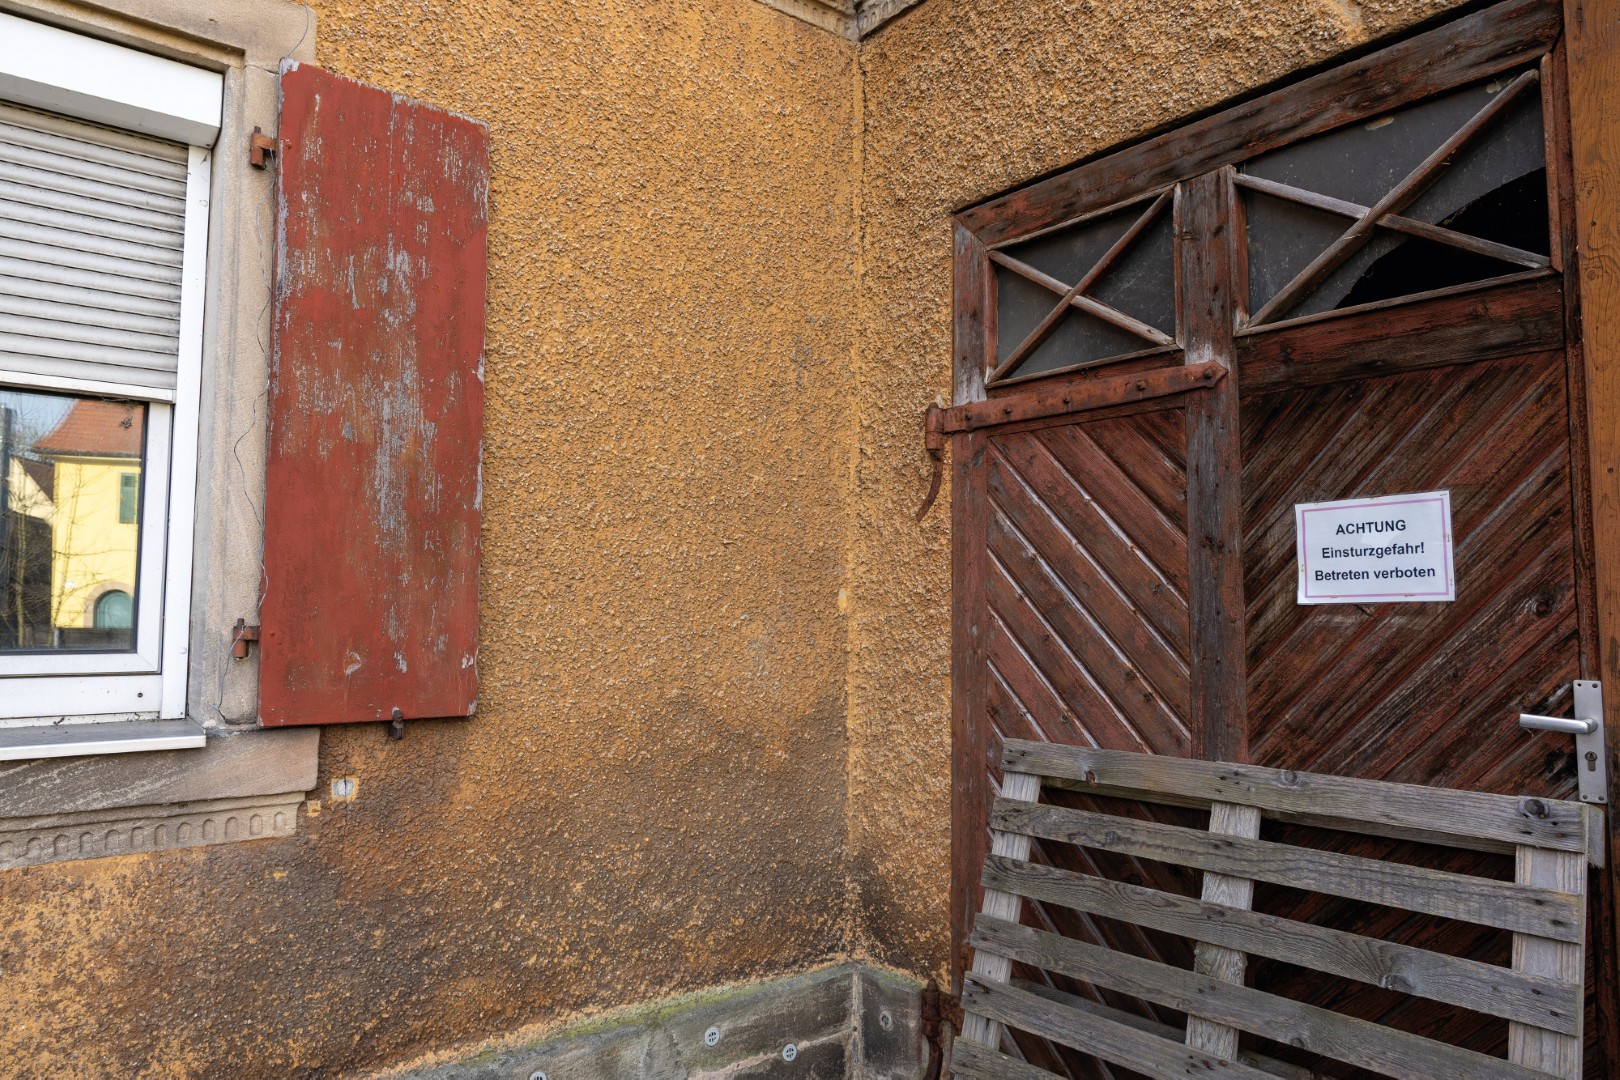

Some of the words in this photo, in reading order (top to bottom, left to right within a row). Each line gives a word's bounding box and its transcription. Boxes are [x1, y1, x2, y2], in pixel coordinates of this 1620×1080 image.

[1335, 519, 1407, 535] ACHTUNG
[1321, 541, 1425, 559] Einsturzgefahr!
[1314, 569, 1370, 581] Betreten
[1373, 566, 1436, 579] verboten
